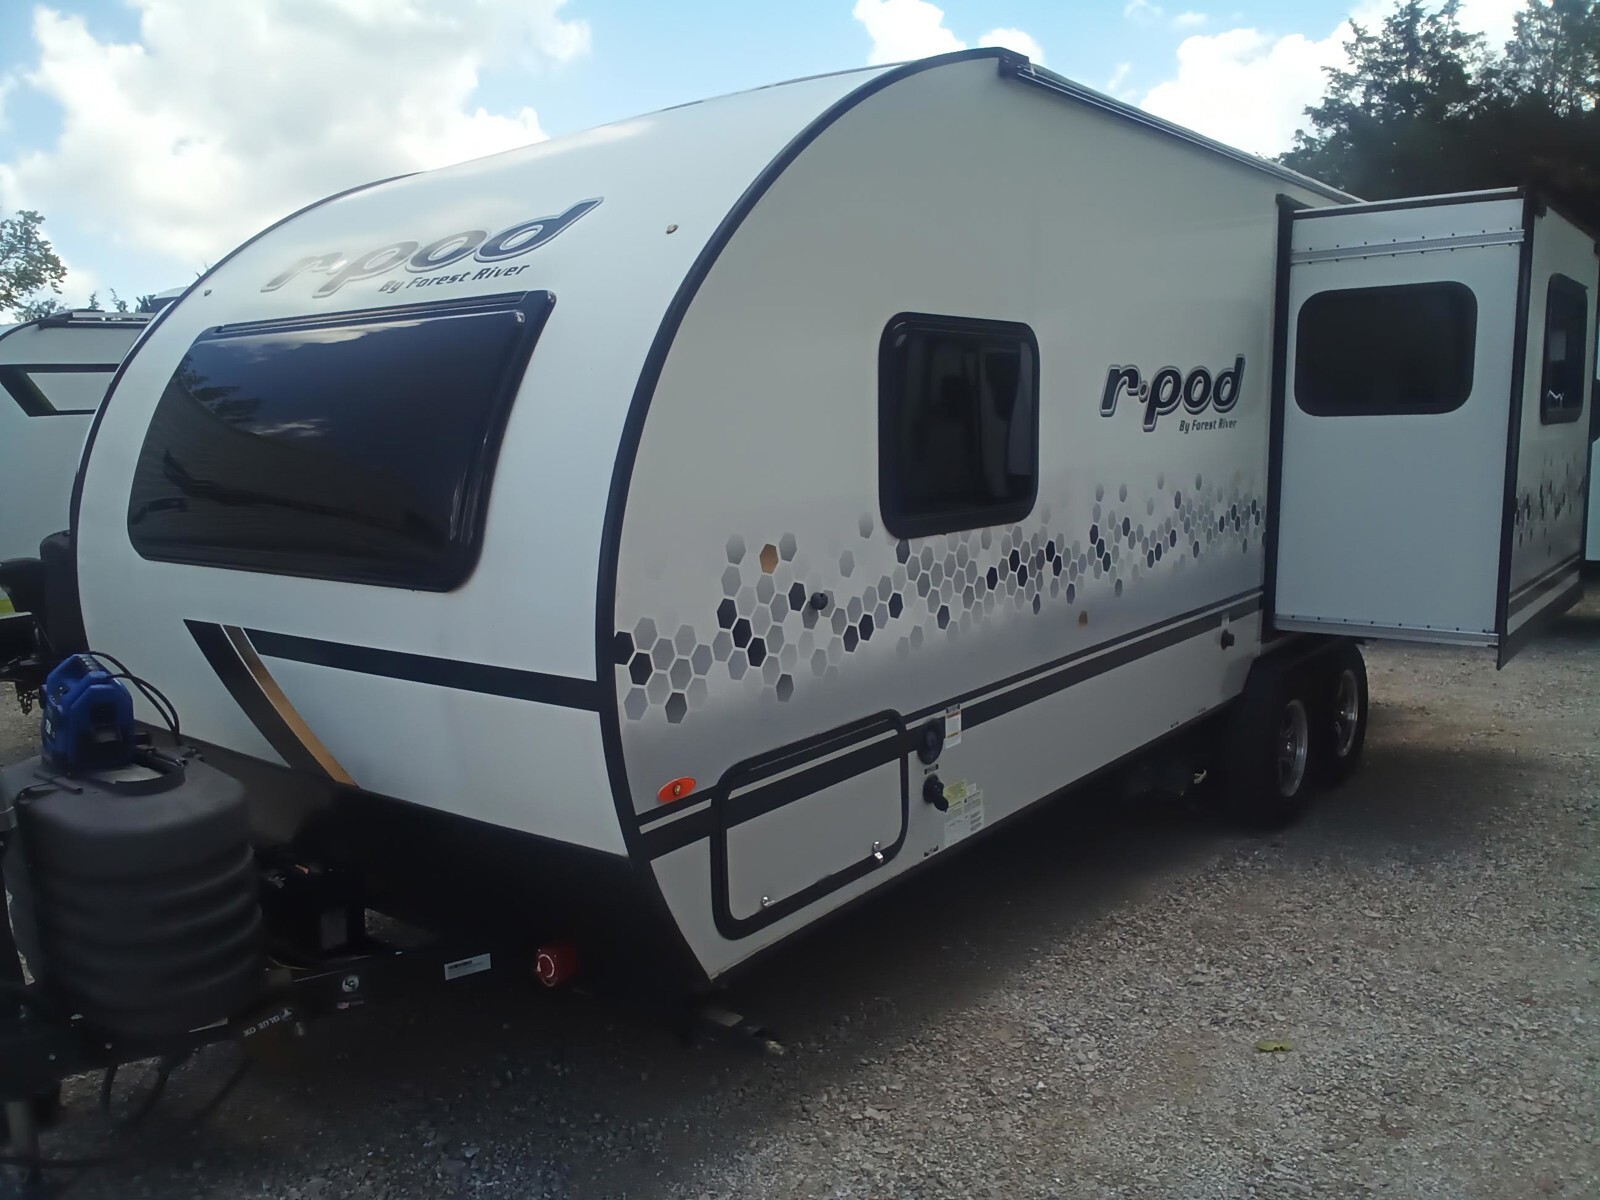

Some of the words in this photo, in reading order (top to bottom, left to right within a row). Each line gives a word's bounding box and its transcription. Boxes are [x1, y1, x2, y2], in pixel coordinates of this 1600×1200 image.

[378, 280, 405, 293] By
[406, 271, 470, 288] Forest
[472, 265, 530, 280] River
[1179, 420, 1190, 434] By
[1192, 420, 1216, 431] Forest
[1218, 418, 1237, 429] River
